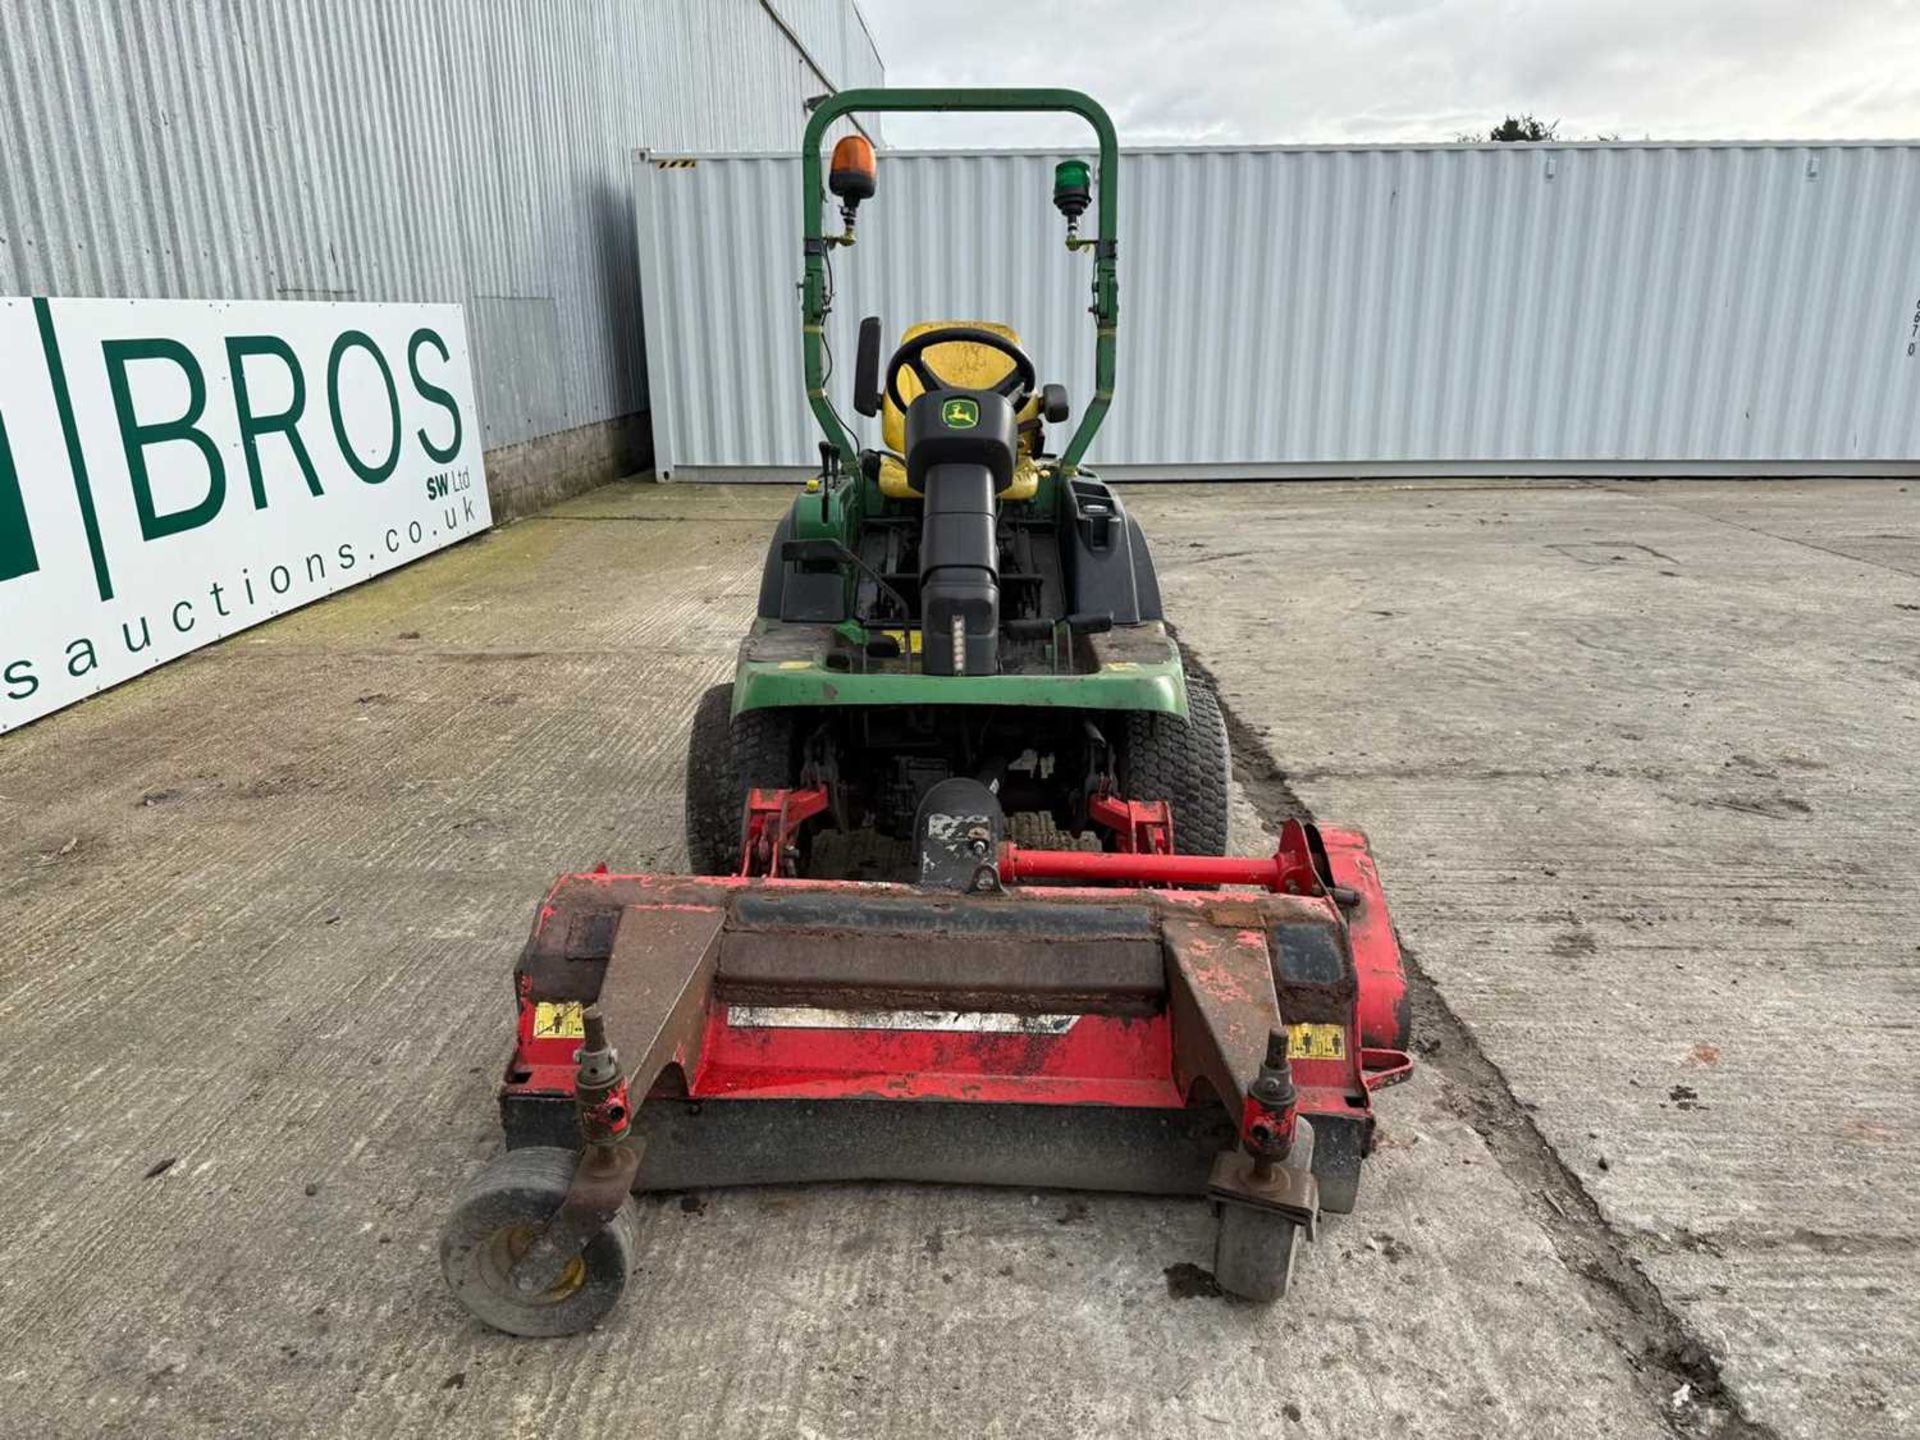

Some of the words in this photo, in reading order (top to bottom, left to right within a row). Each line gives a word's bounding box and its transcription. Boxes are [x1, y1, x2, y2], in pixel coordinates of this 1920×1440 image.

[101, 328, 463, 541] BROS
[426, 472, 449, 500] SW
[451, 466, 471, 493] Ltd
